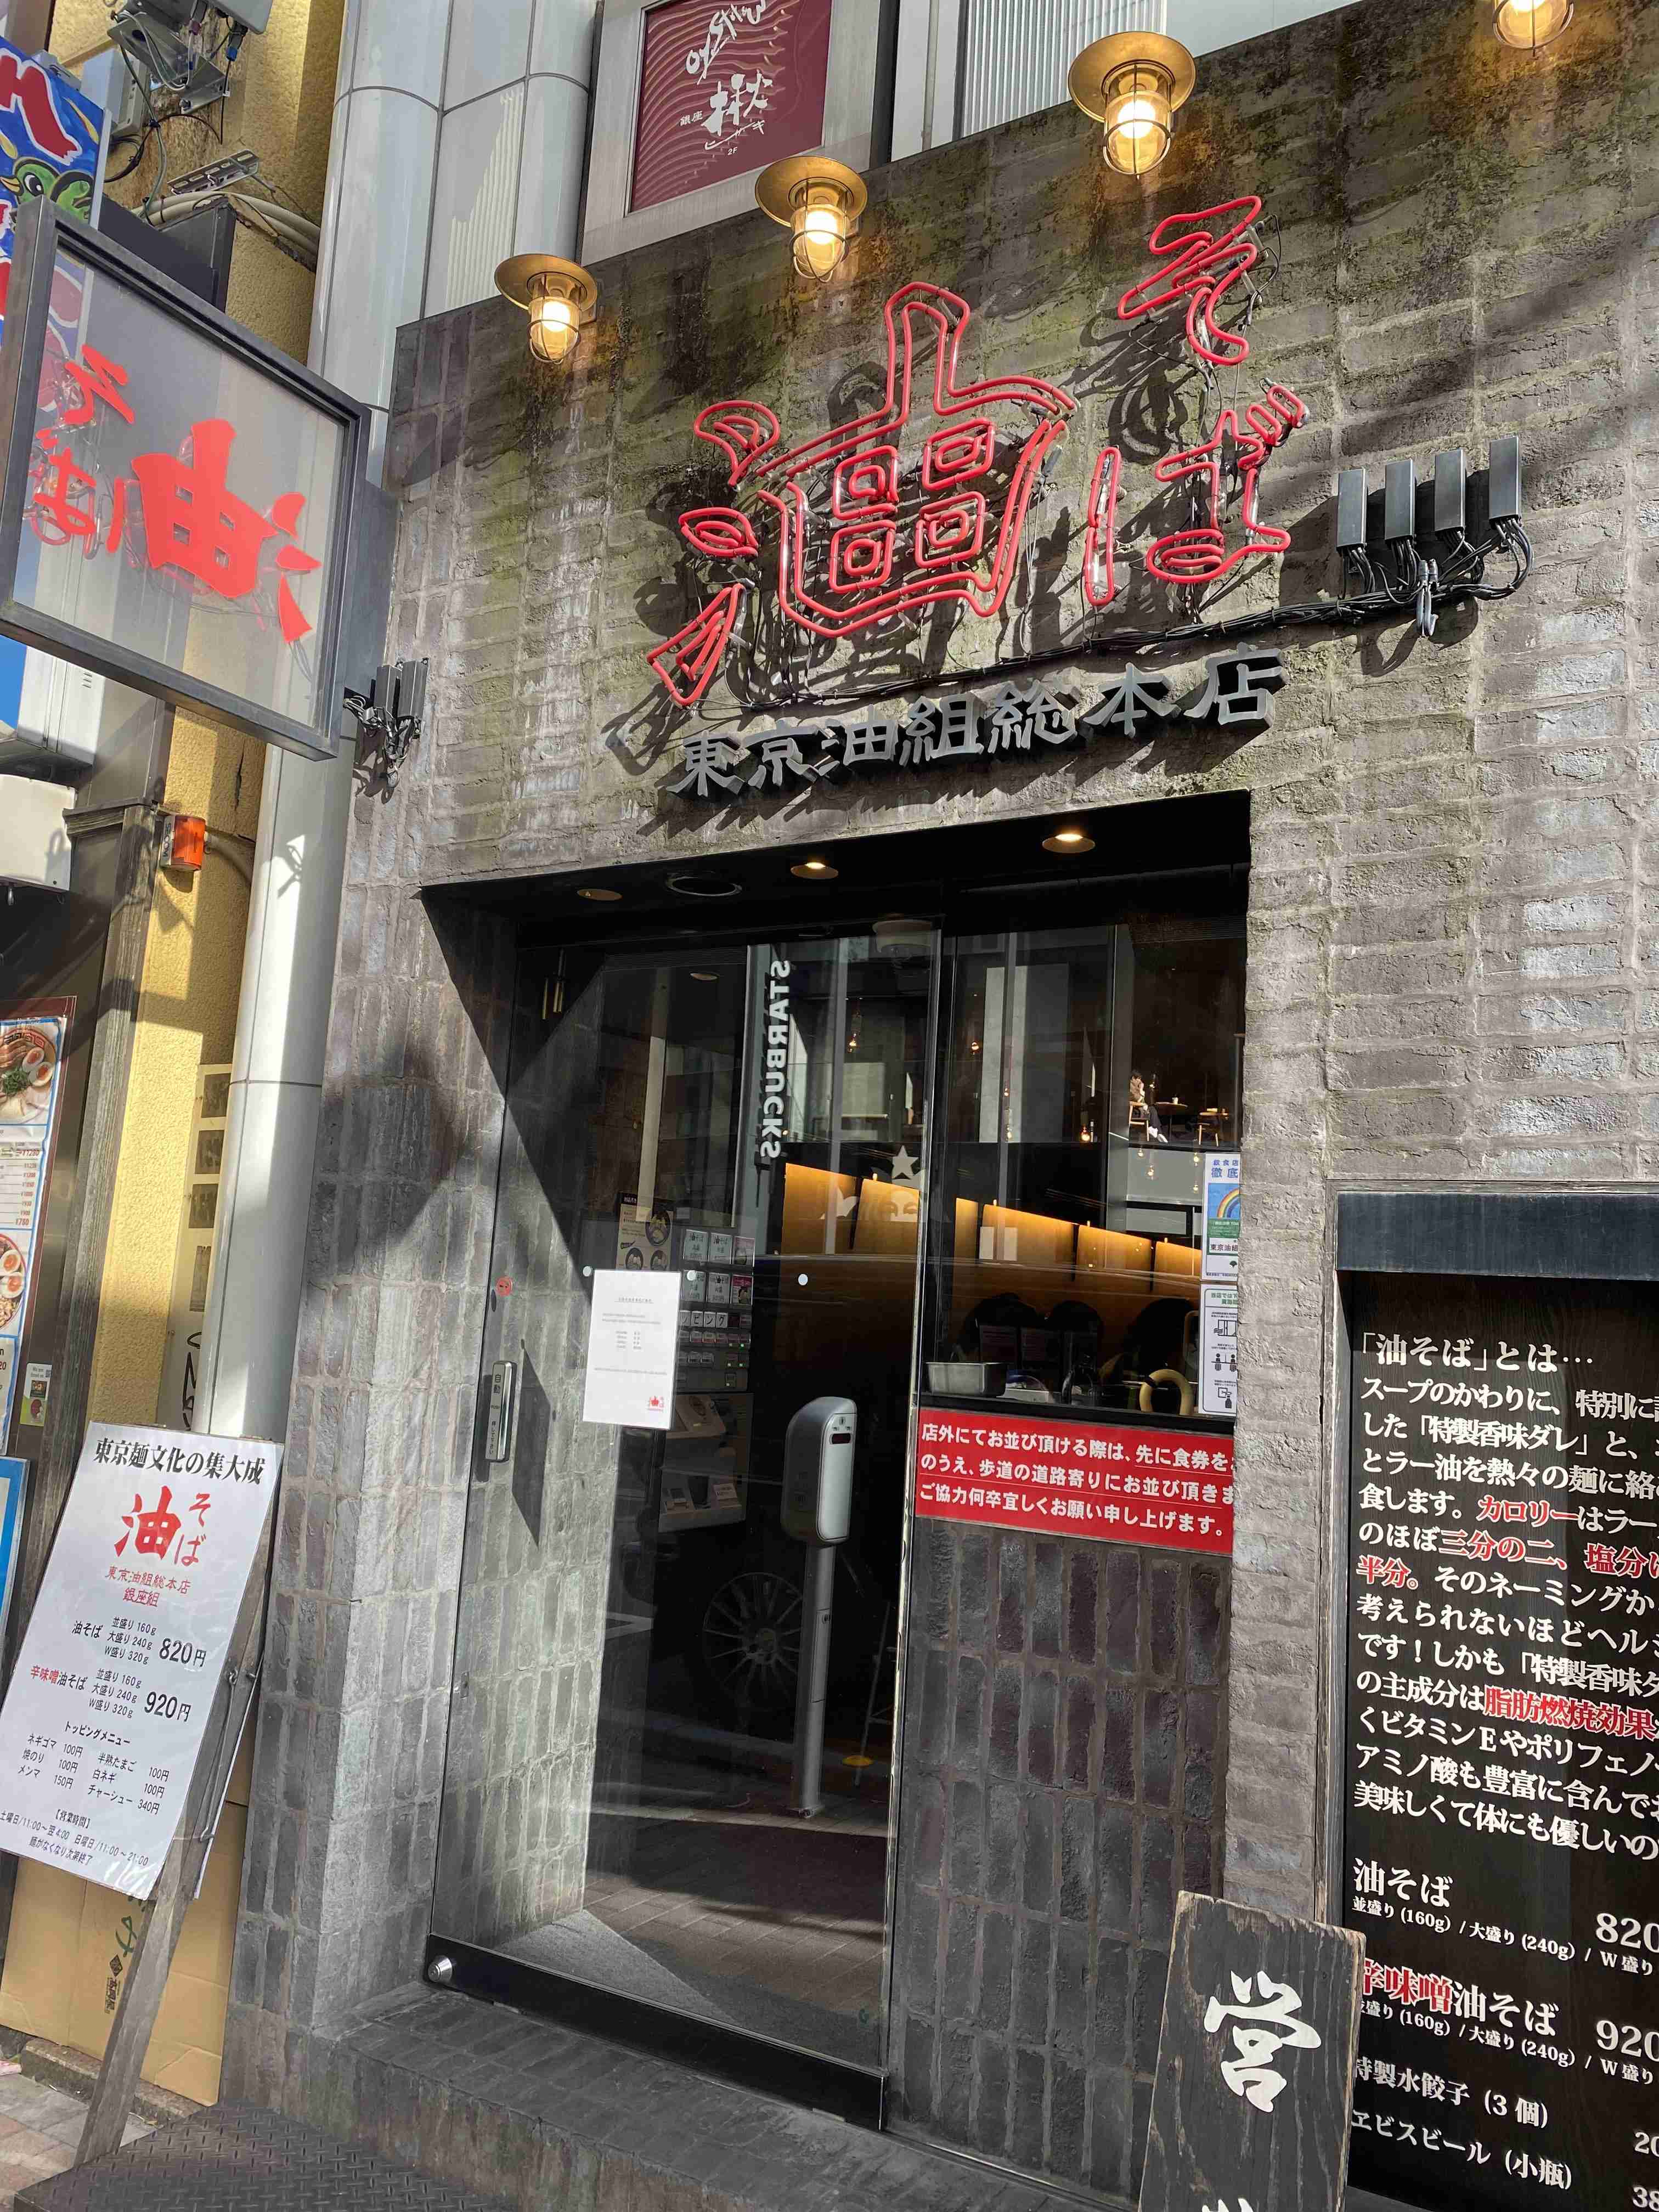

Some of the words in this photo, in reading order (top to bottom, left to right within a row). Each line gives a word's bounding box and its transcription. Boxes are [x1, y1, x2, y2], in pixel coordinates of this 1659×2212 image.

[727, 146, 738, 155] 2F
[667, 646, 1285, 797] 東京油組総本店
[1361, 1377, 1659, 1423] スープのかわりに、特別に
[921, 1423, 1233, 1472] 店外にてお並び頂ける際は、先に食券を
[1364, 1412, 1659, 1459] した「特製香味ダレ」と、
[1363, 1448, 1659, 1500] とラー油を熱々の麺に絡
[105, 1565, 191, 1595] 東京油組総本店
[123, 1587, 160, 1607] 銀座組
[72, 1621, 104, 1639] 油そば
[137, 1622, 157, 1635] 160g
[1356, 1593, 1659, 1655] 考えられないほどヘル
[106, 1630, 131, 1644] 大盛り
[133, 1636, 153, 1651] 240g
[159, 1638, 207, 1668] 820円
[104, 1645, 126, 1660] W盛り
[128, 1650, 149, 1665] 320g
[92, 1683, 115, 1697] 大盛り
[117, 1689, 137, 1704] 240g
[122, 1674, 142, 1689] 160g
[88, 1697, 110, 1712] W盛り
[112, 1703, 134, 1719] 320g
[144, 1691, 192, 1723] 920円
[1357, 1671, 1659, 1741] の主成分は脂肪燃焼効果
[27, 1733, 58, 1750] ネギゴマ
[63, 1743, 83, 1758] 100円
[64, 1720, 131, 1747] トッピングメニュー
[22, 1748, 45, 1764] 焼のり
[58, 1759, 78, 1774] 100円
[149, 1767, 170, 1782] 100円
[18, 1764, 41, 1778] メンマ
[54, 1775, 74, 1790] 150円
[92, 1769, 116, 1784] 白ネギ
[144, 1783, 165, 1798] 100円
[88, 1785, 133, 1805] チャーシュー
[137, 1799, 161, 1815] 340円
[1353, 1858, 1453, 1908] 油そば
